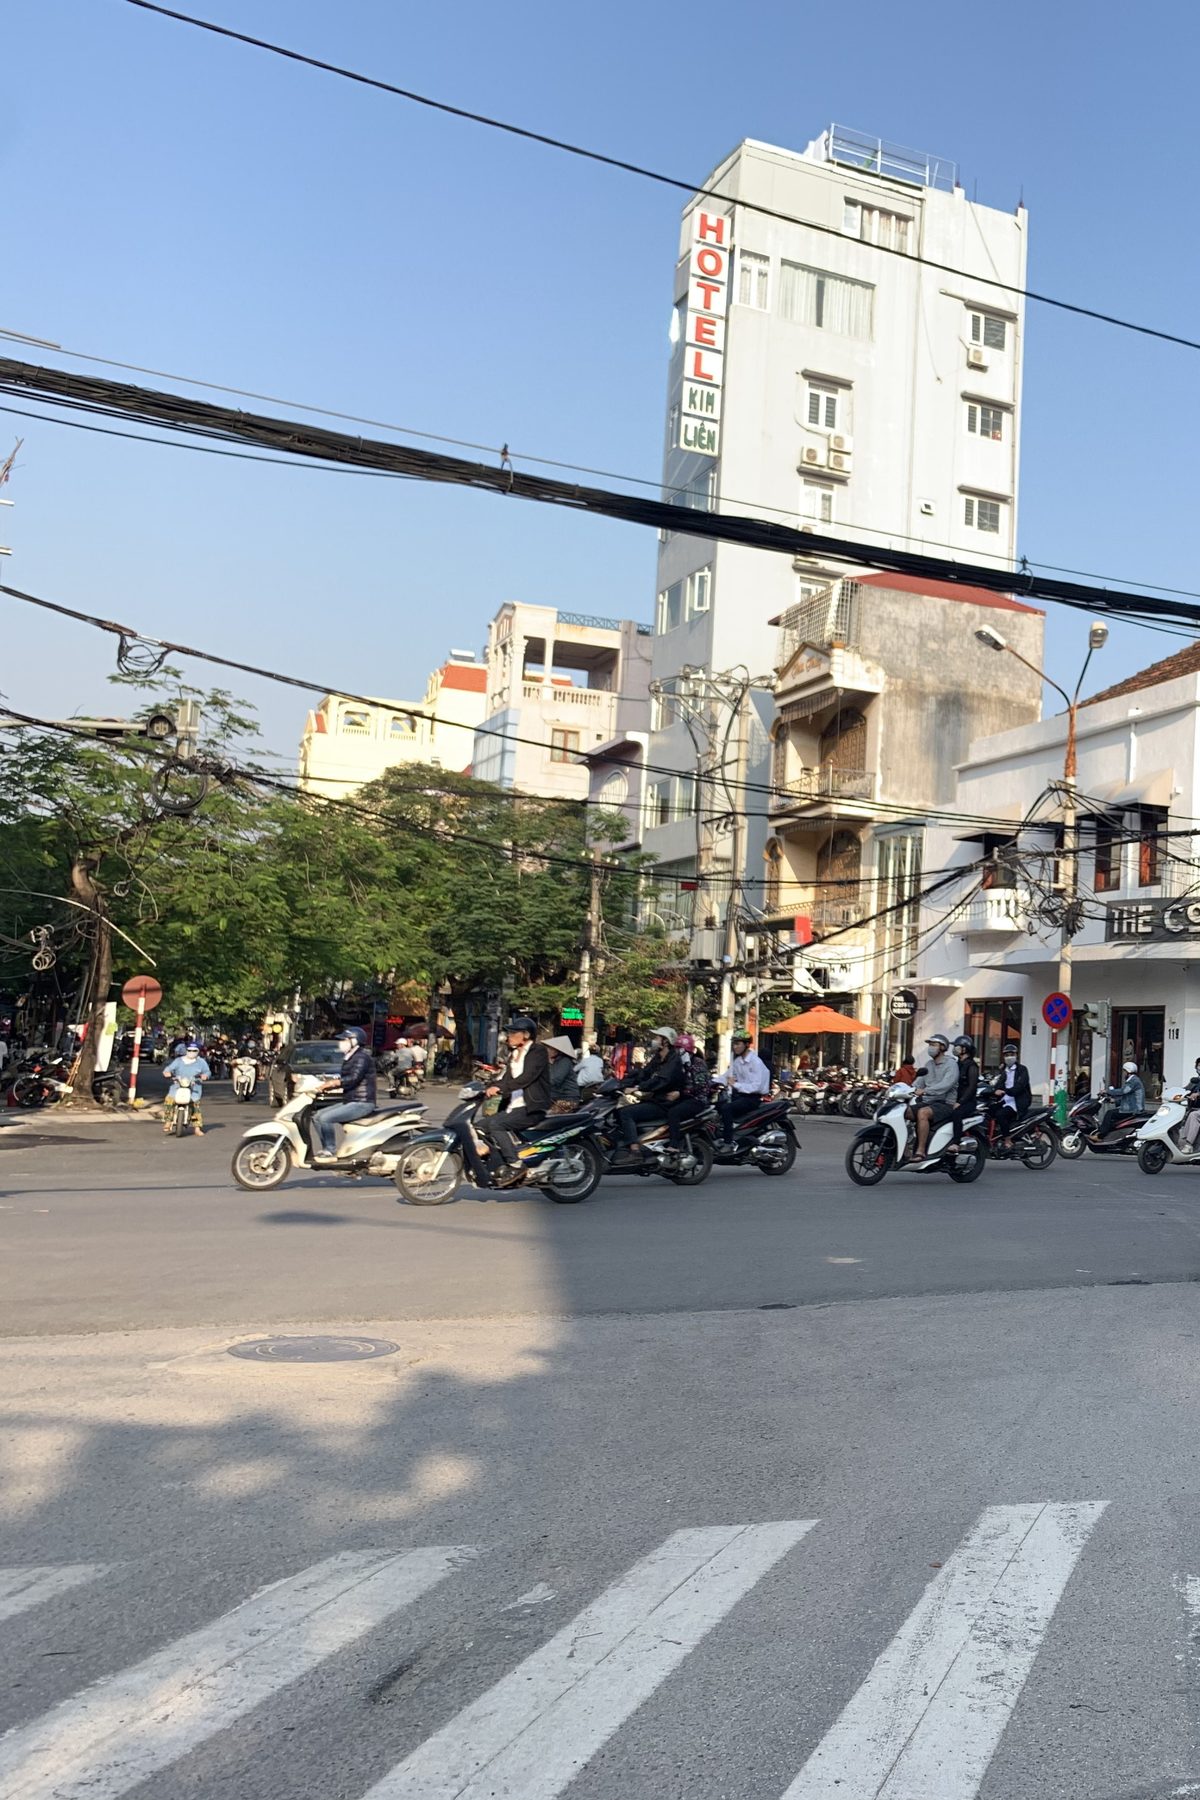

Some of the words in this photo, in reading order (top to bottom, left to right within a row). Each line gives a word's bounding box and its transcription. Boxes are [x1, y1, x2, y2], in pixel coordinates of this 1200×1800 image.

[694, 213, 724, 381] HOTEL
[688, 386, 715, 413] KIM
[684, 420, 716, 452] LIÊN
[1111, 904, 1153, 933] THE
